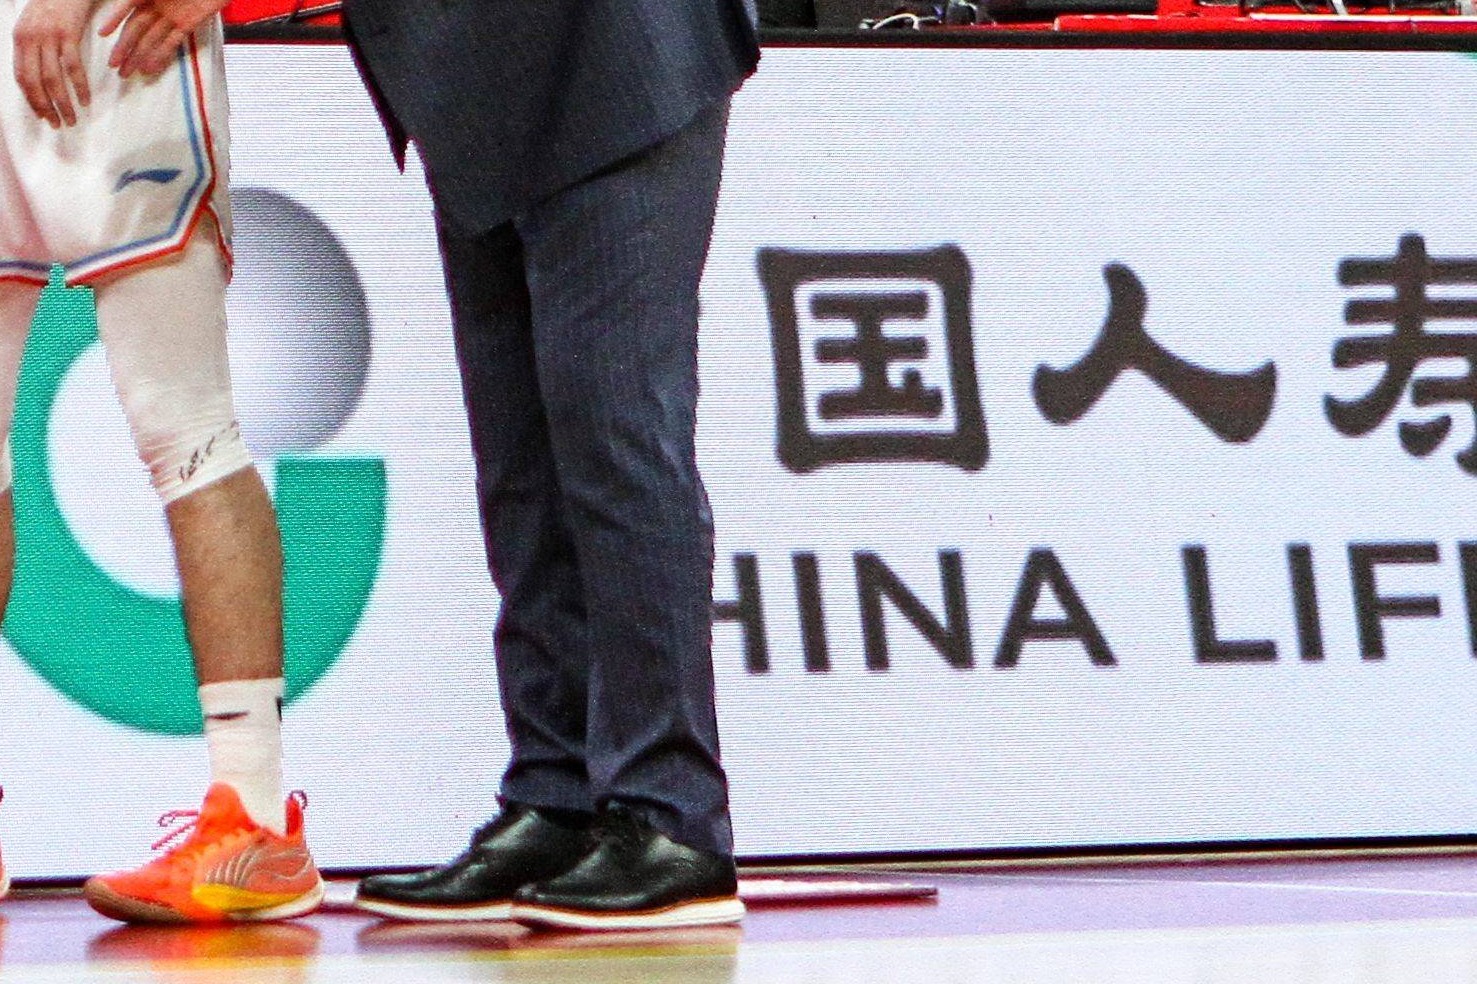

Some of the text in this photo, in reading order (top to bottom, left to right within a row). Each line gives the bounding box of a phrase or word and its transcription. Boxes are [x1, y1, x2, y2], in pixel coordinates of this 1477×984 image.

[756, 232, 1477, 477] 国人寿
[712, 546, 1119, 675] HINA
